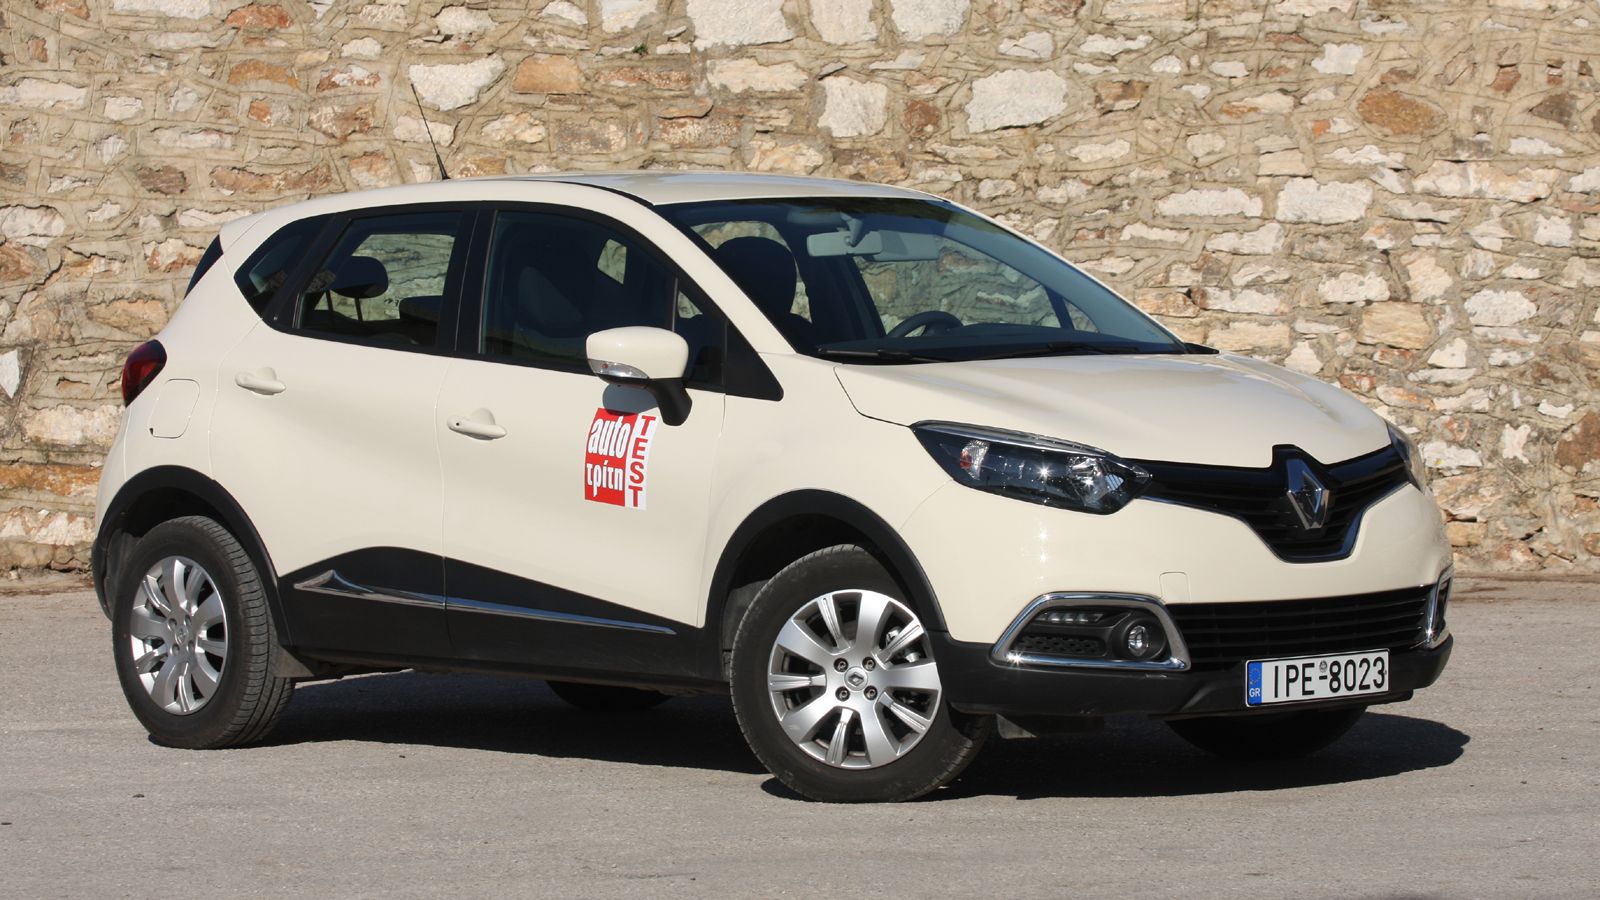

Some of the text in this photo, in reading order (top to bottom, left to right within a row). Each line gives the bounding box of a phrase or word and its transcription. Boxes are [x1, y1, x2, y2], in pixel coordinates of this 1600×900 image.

[588, 415, 631, 458] auto
[628, 415, 656, 507] TEST
[1249, 687, 1261, 698] GR
[1274, 656, 1385, 698] IPE-8023
